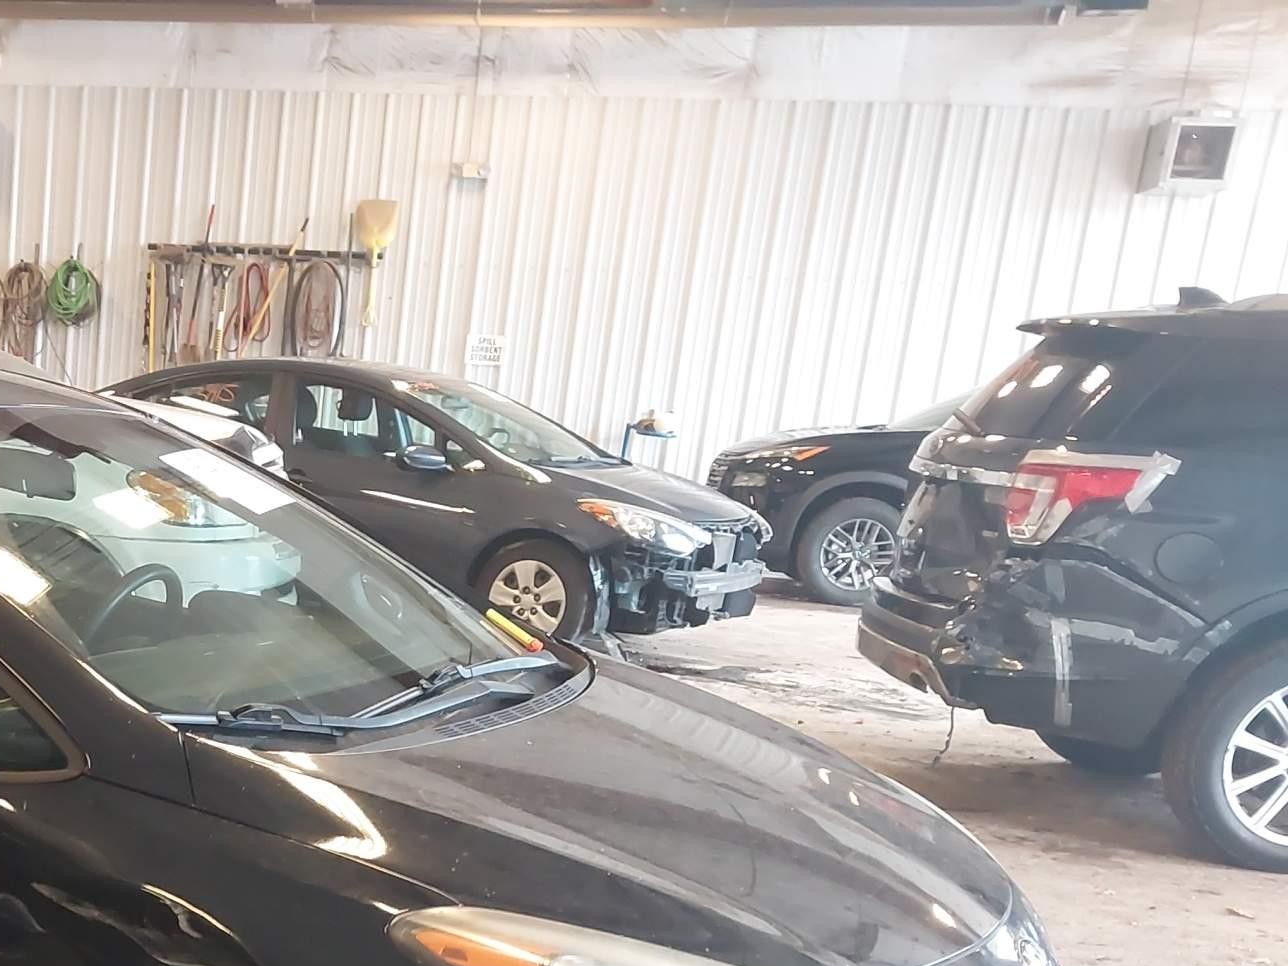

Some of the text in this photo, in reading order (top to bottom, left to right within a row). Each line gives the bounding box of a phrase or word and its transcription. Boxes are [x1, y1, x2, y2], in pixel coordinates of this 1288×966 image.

[478, 337, 496, 345] SPILL
[472, 345, 502, 354] SORBENT
[471, 353, 500, 362] STORAGE
